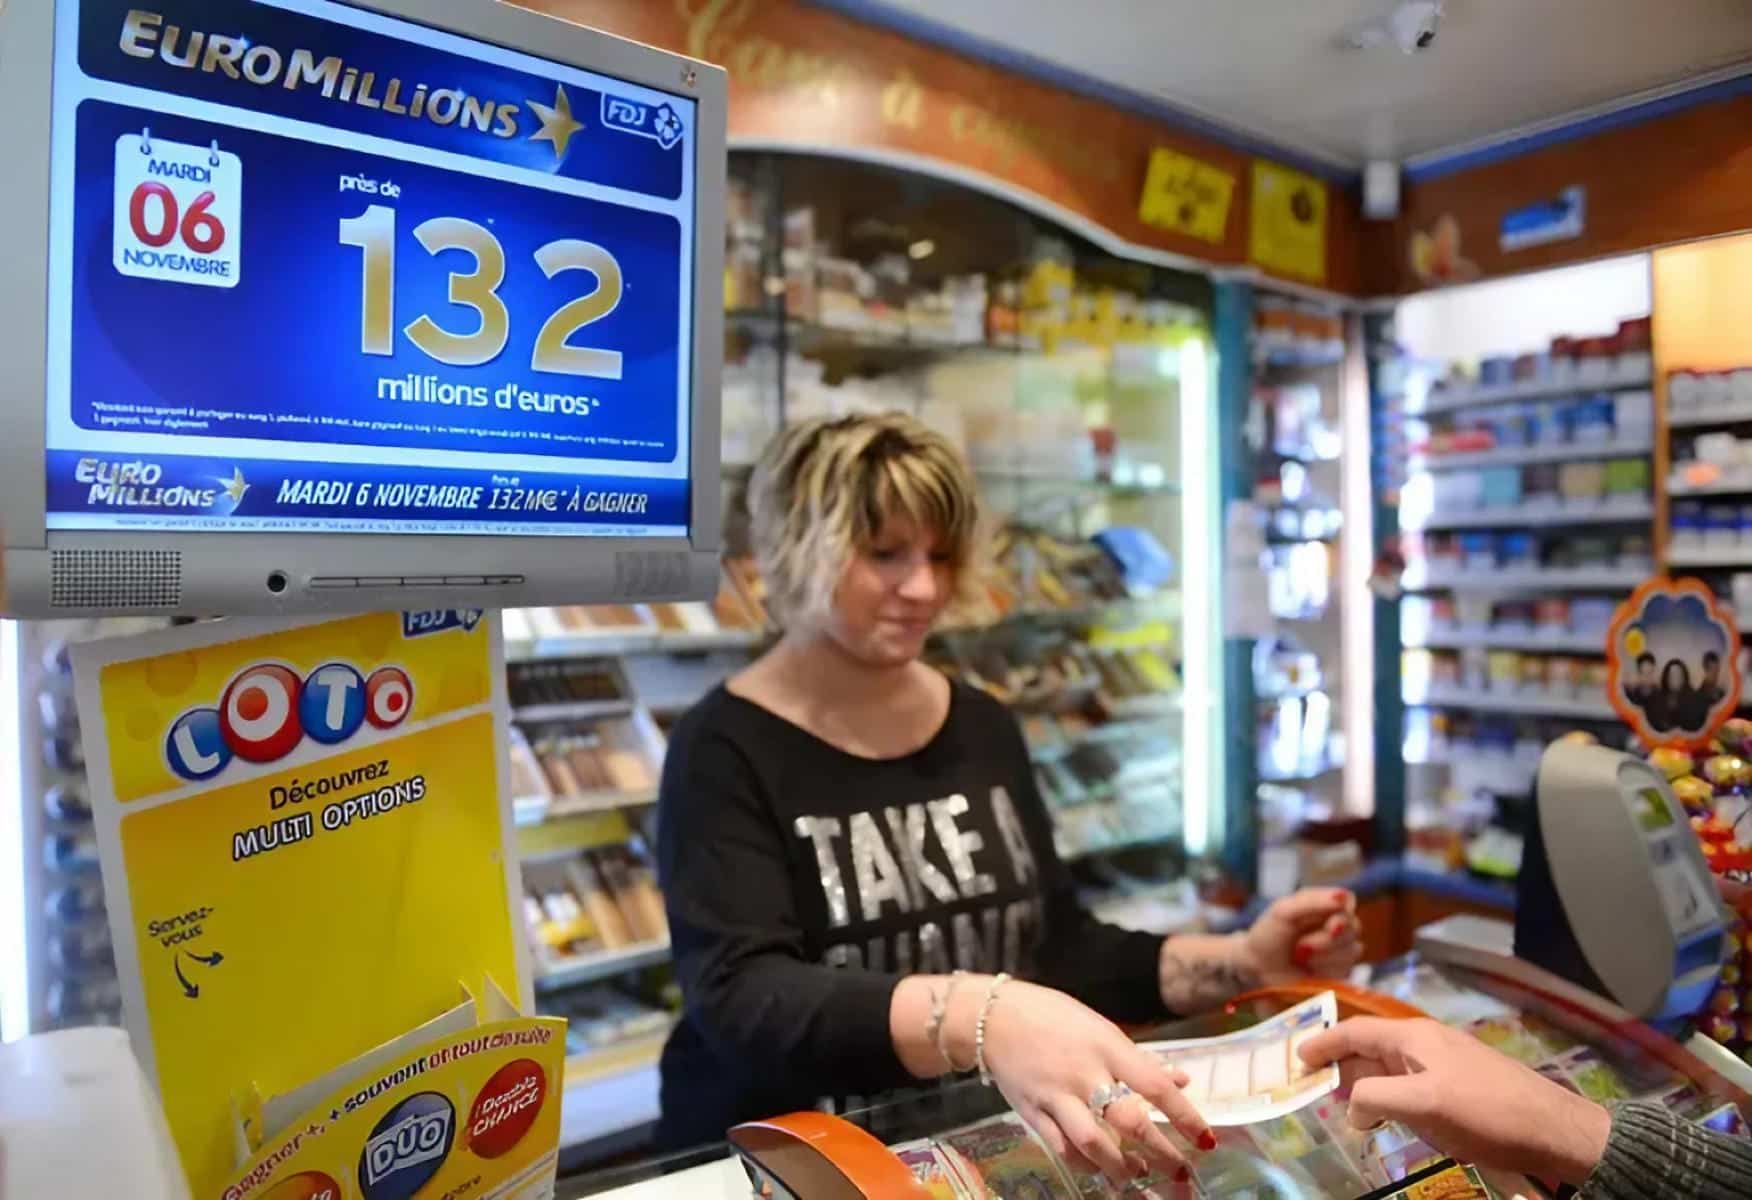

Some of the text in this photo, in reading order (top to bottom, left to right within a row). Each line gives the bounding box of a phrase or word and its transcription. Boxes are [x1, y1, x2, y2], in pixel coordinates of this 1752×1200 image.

[607, 100, 648, 125] FDJ
[148, 159, 212, 184] MARDI
[339, 173, 401, 198] près de
[128, 180, 226, 255] 06
[123, 248, 232, 278] NOVEMBRE
[338, 204, 624, 380] 132
[377, 373, 488, 407] millions
[75, 457, 162, 486] EURO
[276, 479, 353, 505] MARDI
[355, 483, 372, 507] 6
[373, 484, 484, 509] NOVEMBRE
[583, 491, 649, 514] GAGNER
[169, 665, 413, 780] LOTO
[269, 759, 390, 810] Découvrez
[232, 774, 426, 861] MULTI OPTIONS
[794, 793, 998, 926] TAKE
